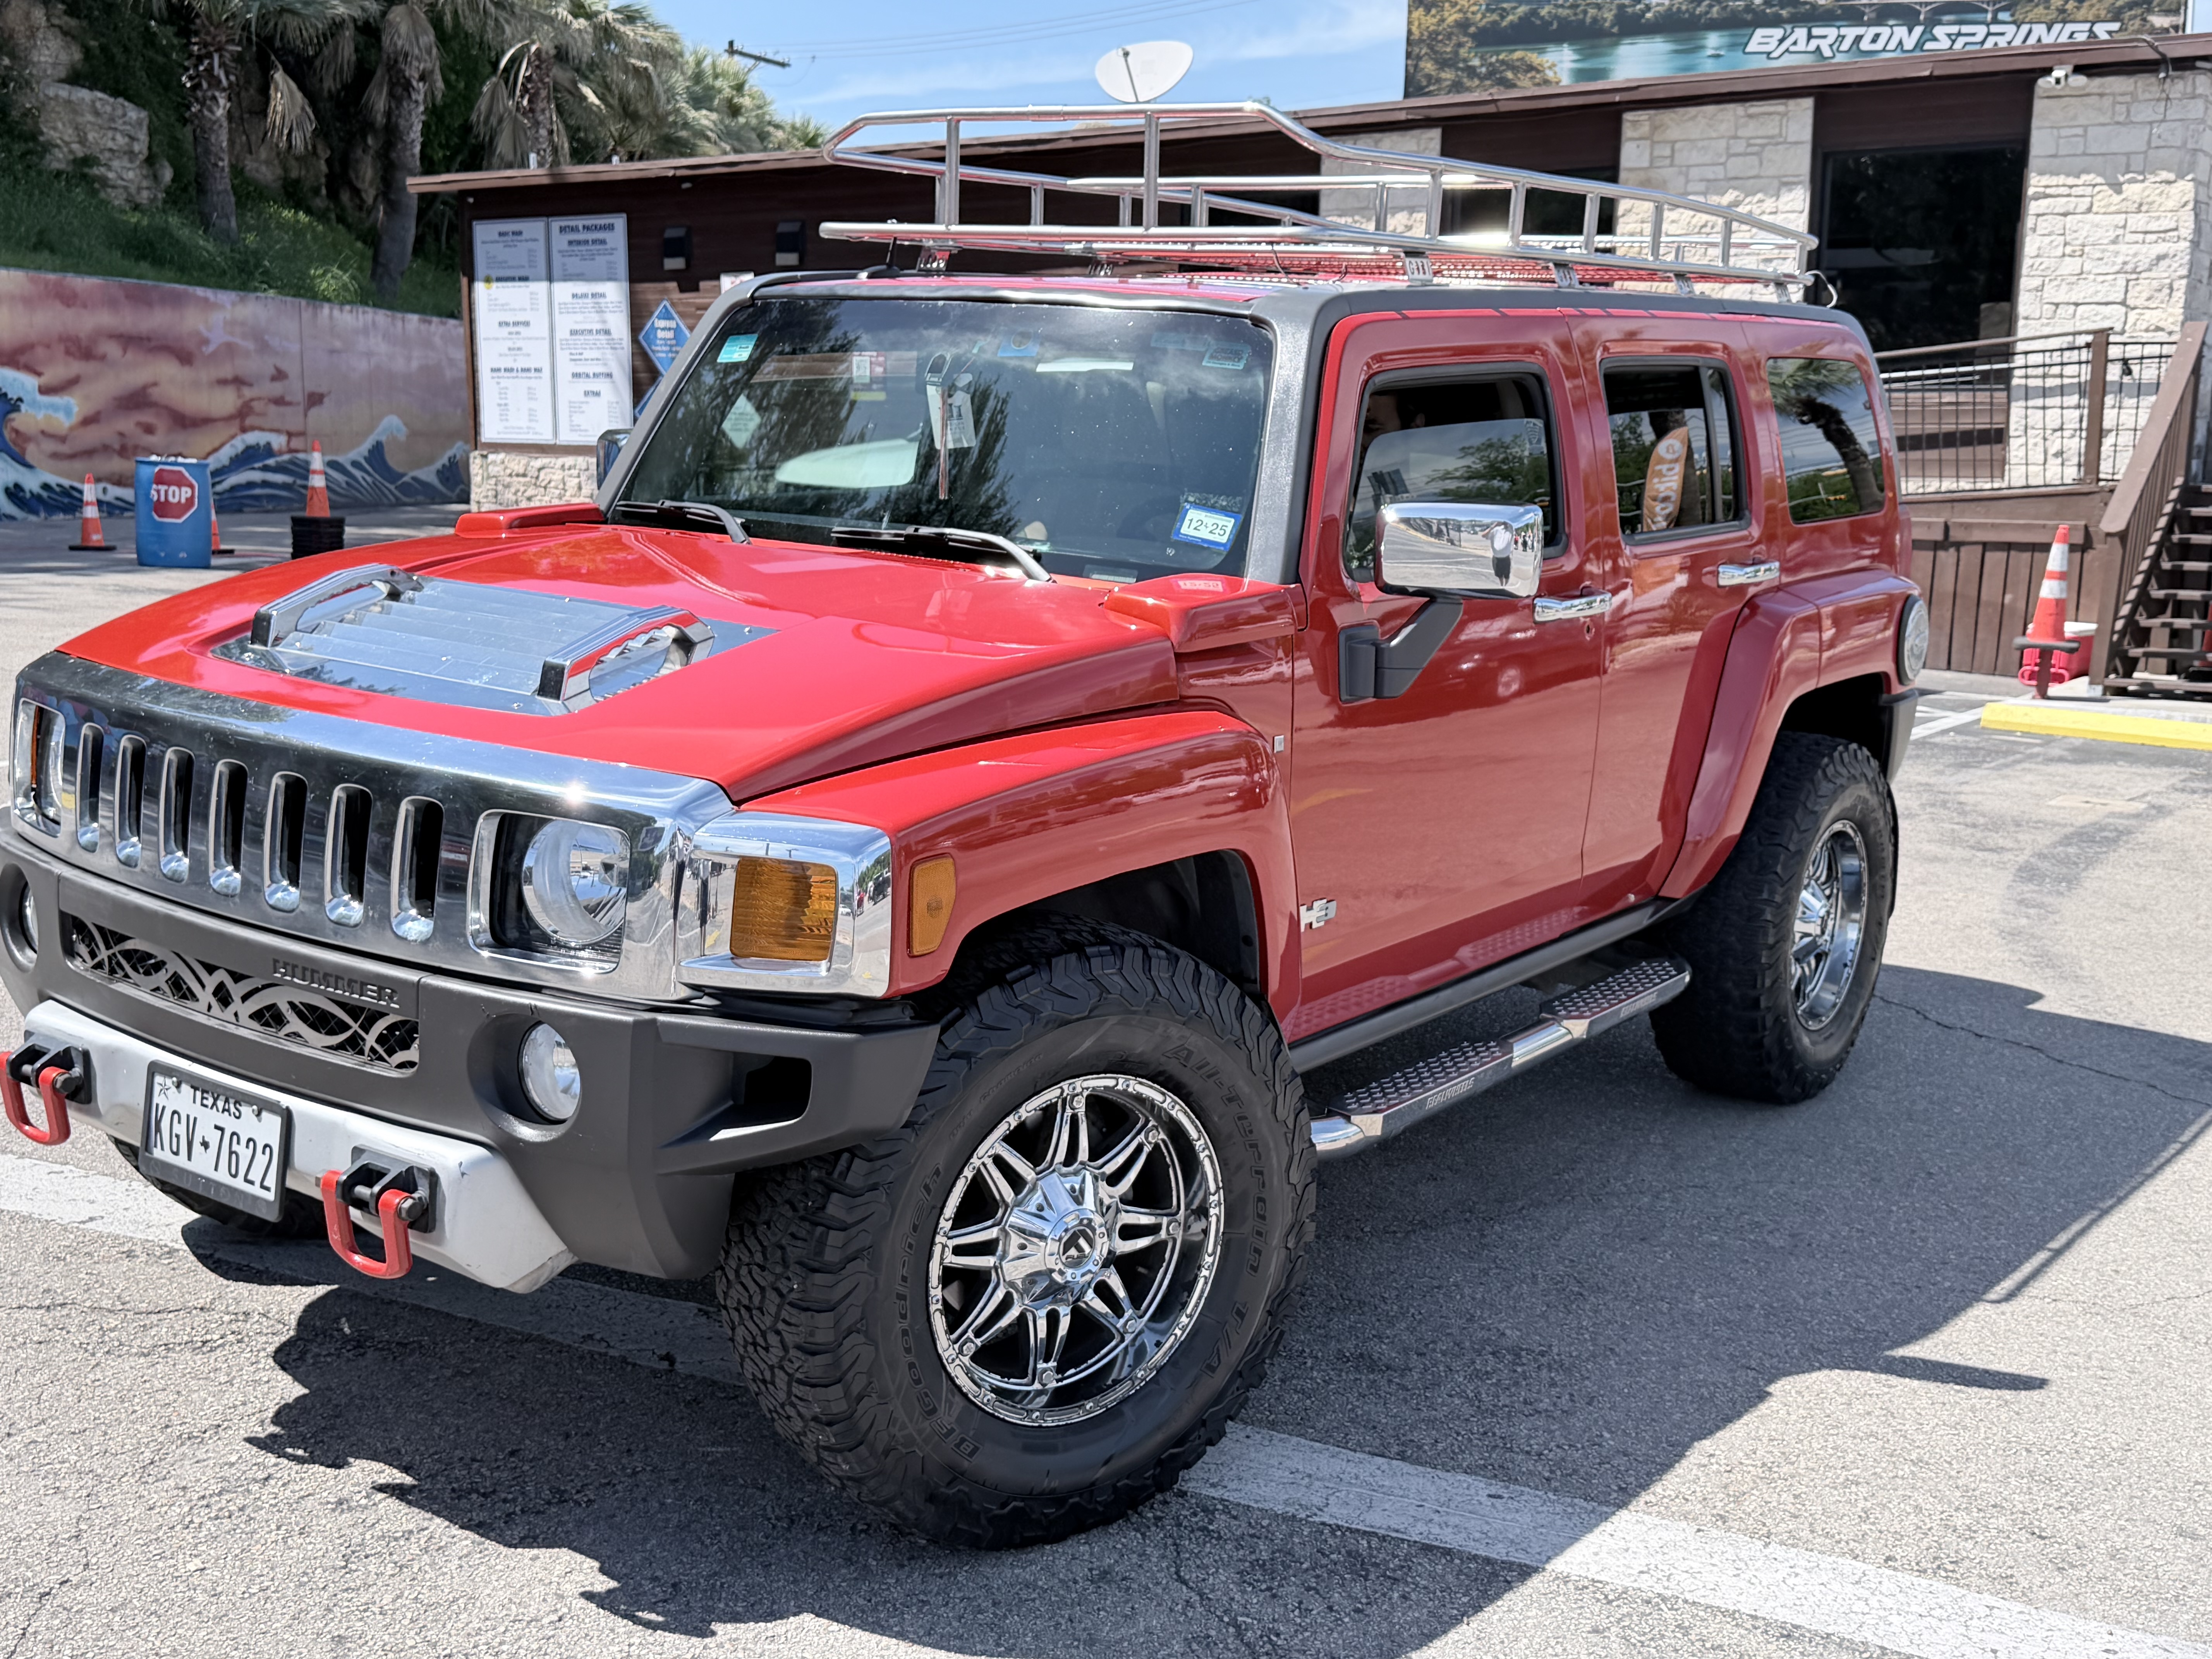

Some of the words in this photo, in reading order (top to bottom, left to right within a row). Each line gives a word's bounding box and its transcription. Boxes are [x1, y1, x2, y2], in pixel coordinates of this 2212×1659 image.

[1745, 25, 1925, 58] BARTON
[1923, 22, 2122, 50] SPRINGS
[560, 225, 580, 234] DETAIL
[582, 223, 615, 232] PACKAGES
[150, 484, 192, 503] STOP
[1187, 518, 1204, 531] 12
[1208, 522, 1228, 537] 25
[272, 958, 400, 1008] HUMMER
[190, 1084, 242, 1120] TEXAS
[153, 1103, 198, 1162] KGV
[213, 1123, 274, 1193] 7622
[895, 1163, 983, 1463] BFGoodrich
[1200, 1301, 1249, 1378] T/A
